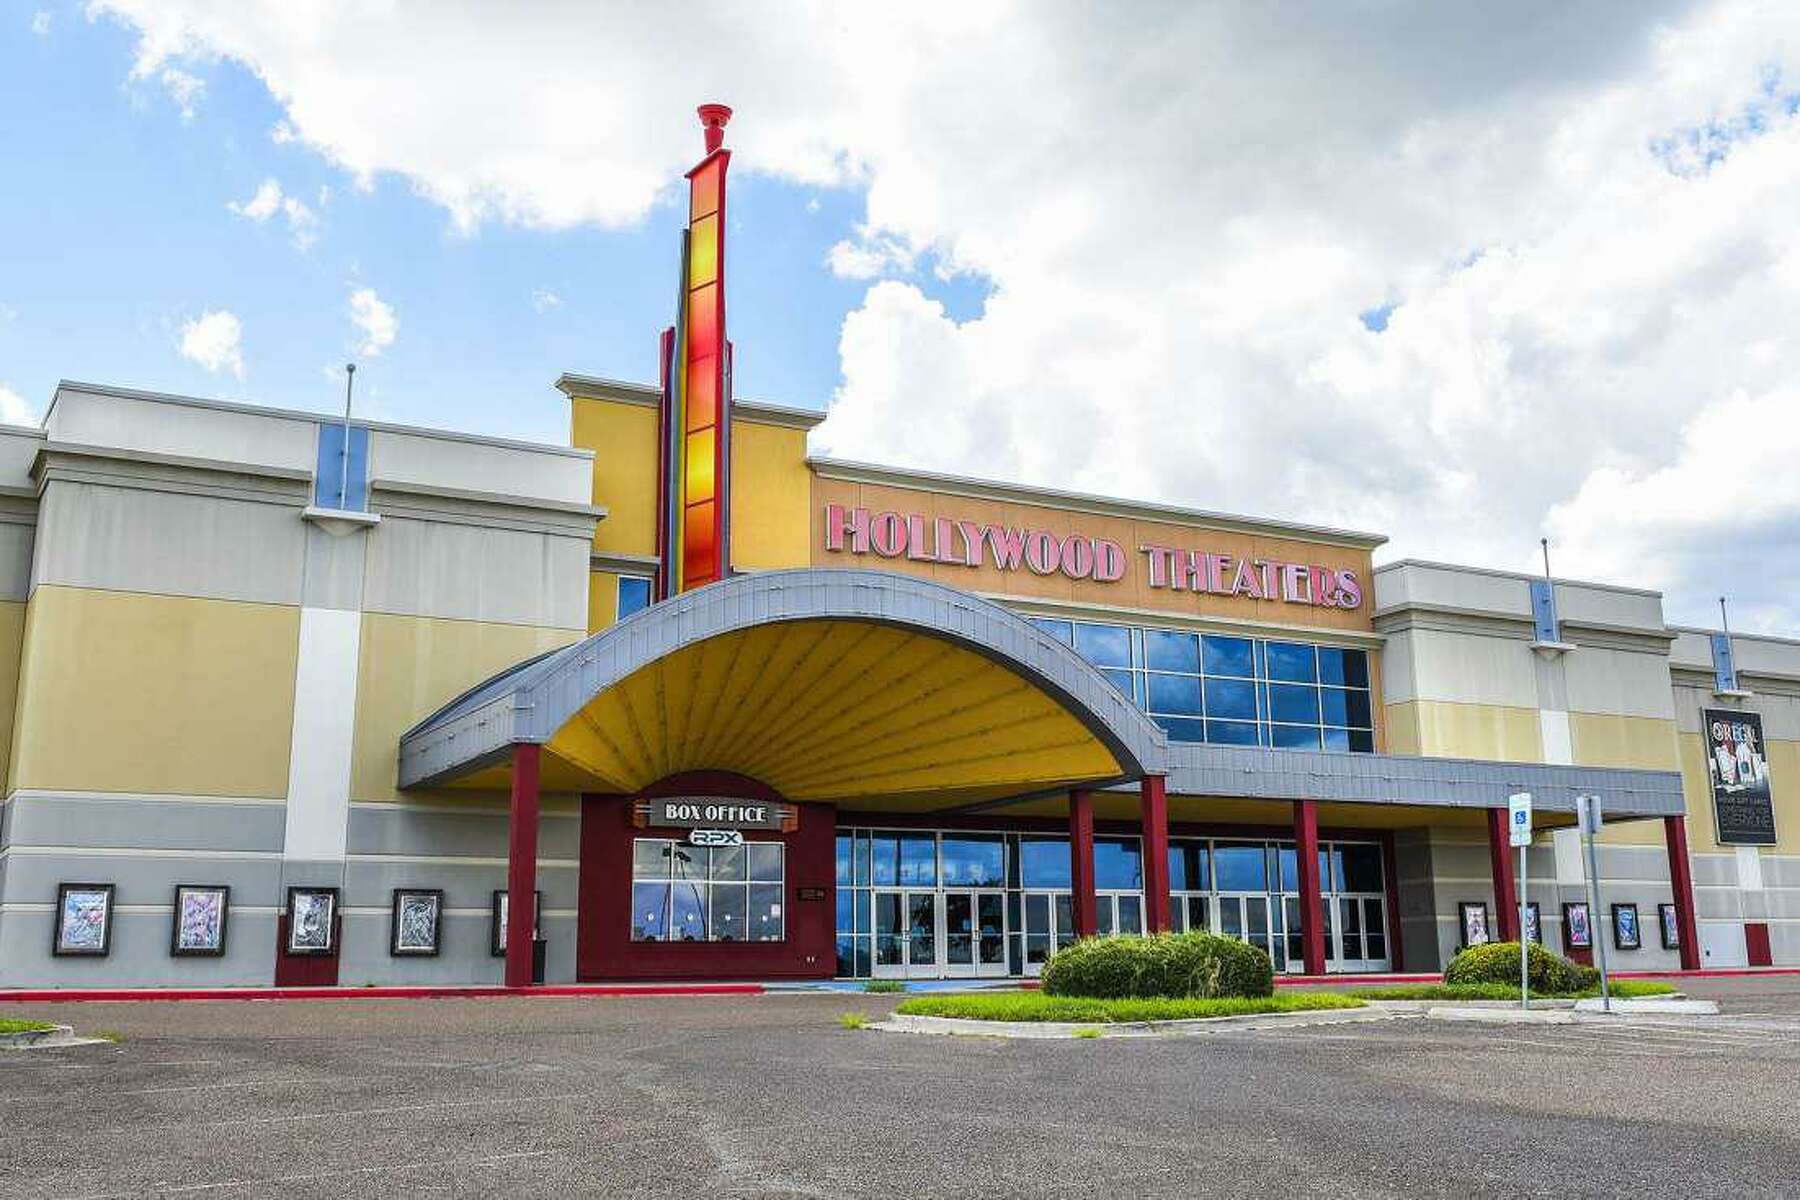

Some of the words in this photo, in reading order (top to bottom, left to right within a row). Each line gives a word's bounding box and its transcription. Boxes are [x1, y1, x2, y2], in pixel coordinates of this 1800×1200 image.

[825, 503, 1128, 583] HOLLYWOOD
[1138, 544, 1363, 609] THEATERS
[665, 803, 701, 821] BOX
[704, 805, 767, 822] OFFICE
[693, 832, 739, 844] RPX
